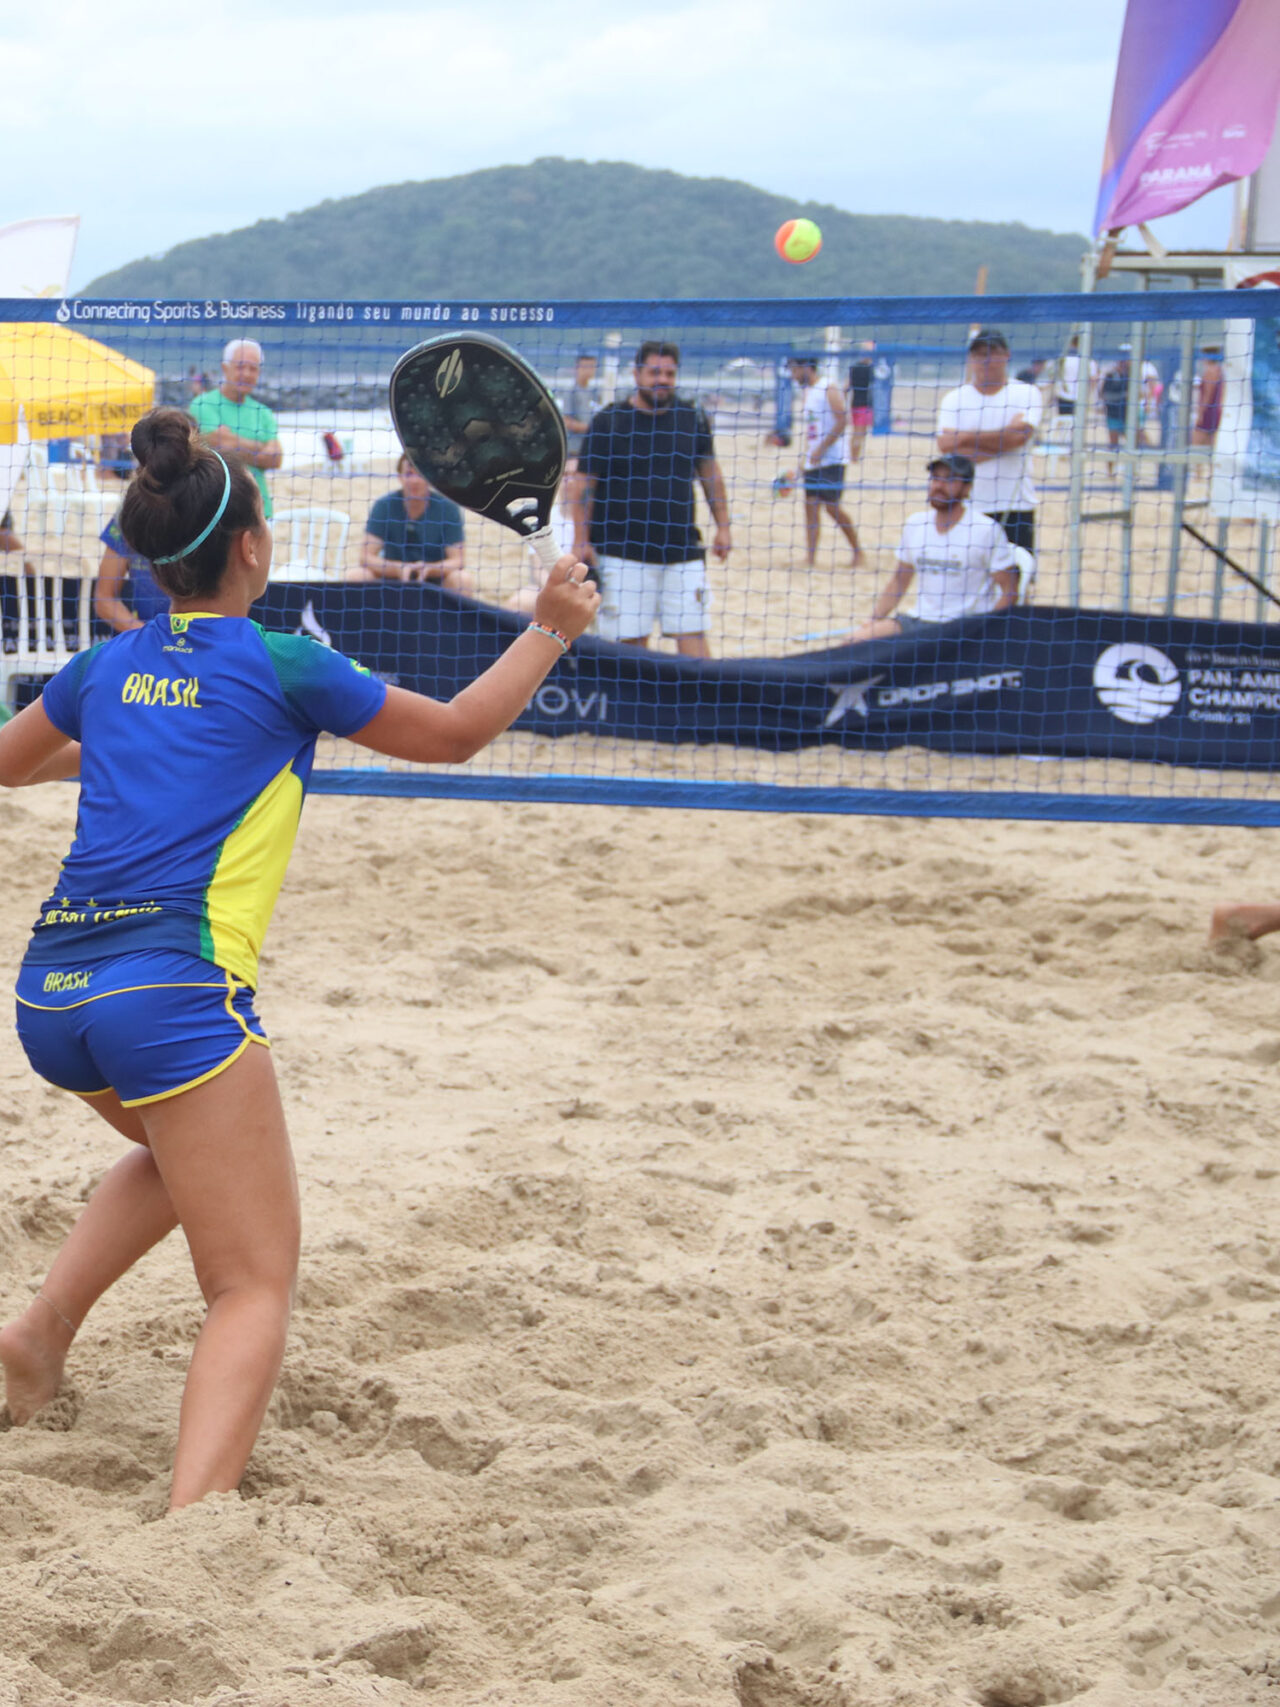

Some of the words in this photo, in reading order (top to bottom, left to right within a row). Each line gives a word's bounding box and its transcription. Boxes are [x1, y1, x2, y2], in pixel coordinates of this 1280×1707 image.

[73, 300, 150, 323] Connecting
[153, 300, 201, 323] Sports
[204, 300, 218, 319] &
[221, 300, 286, 319] Business
[297, 303, 354, 323] ligando
[364, 305, 391, 321] seu
[401, 303, 451, 321] mundo
[461, 306, 480, 321] ao
[490, 306, 555, 322] sucesso
[122, 672, 202, 708] BRASIL
[526, 685, 608, 720] OVI
[43, 971, 93, 992] BRASIL
